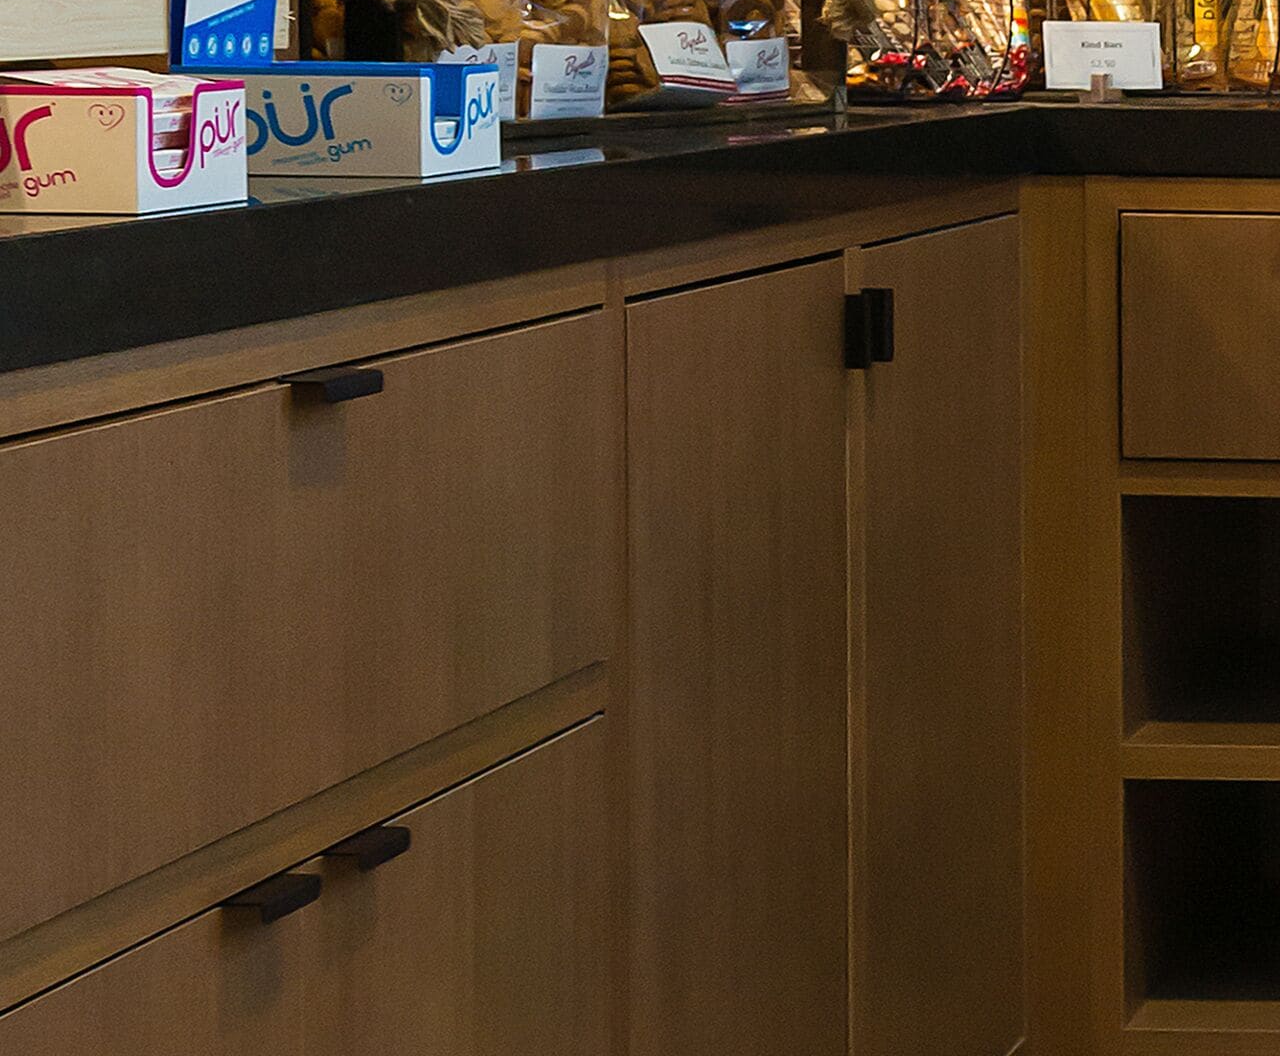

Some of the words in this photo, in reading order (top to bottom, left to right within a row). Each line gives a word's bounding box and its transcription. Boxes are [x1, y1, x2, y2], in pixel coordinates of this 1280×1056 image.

[200, 99, 240, 169] pür
[327, 137, 373, 163] gum
[24, 169, 77, 197] gum
